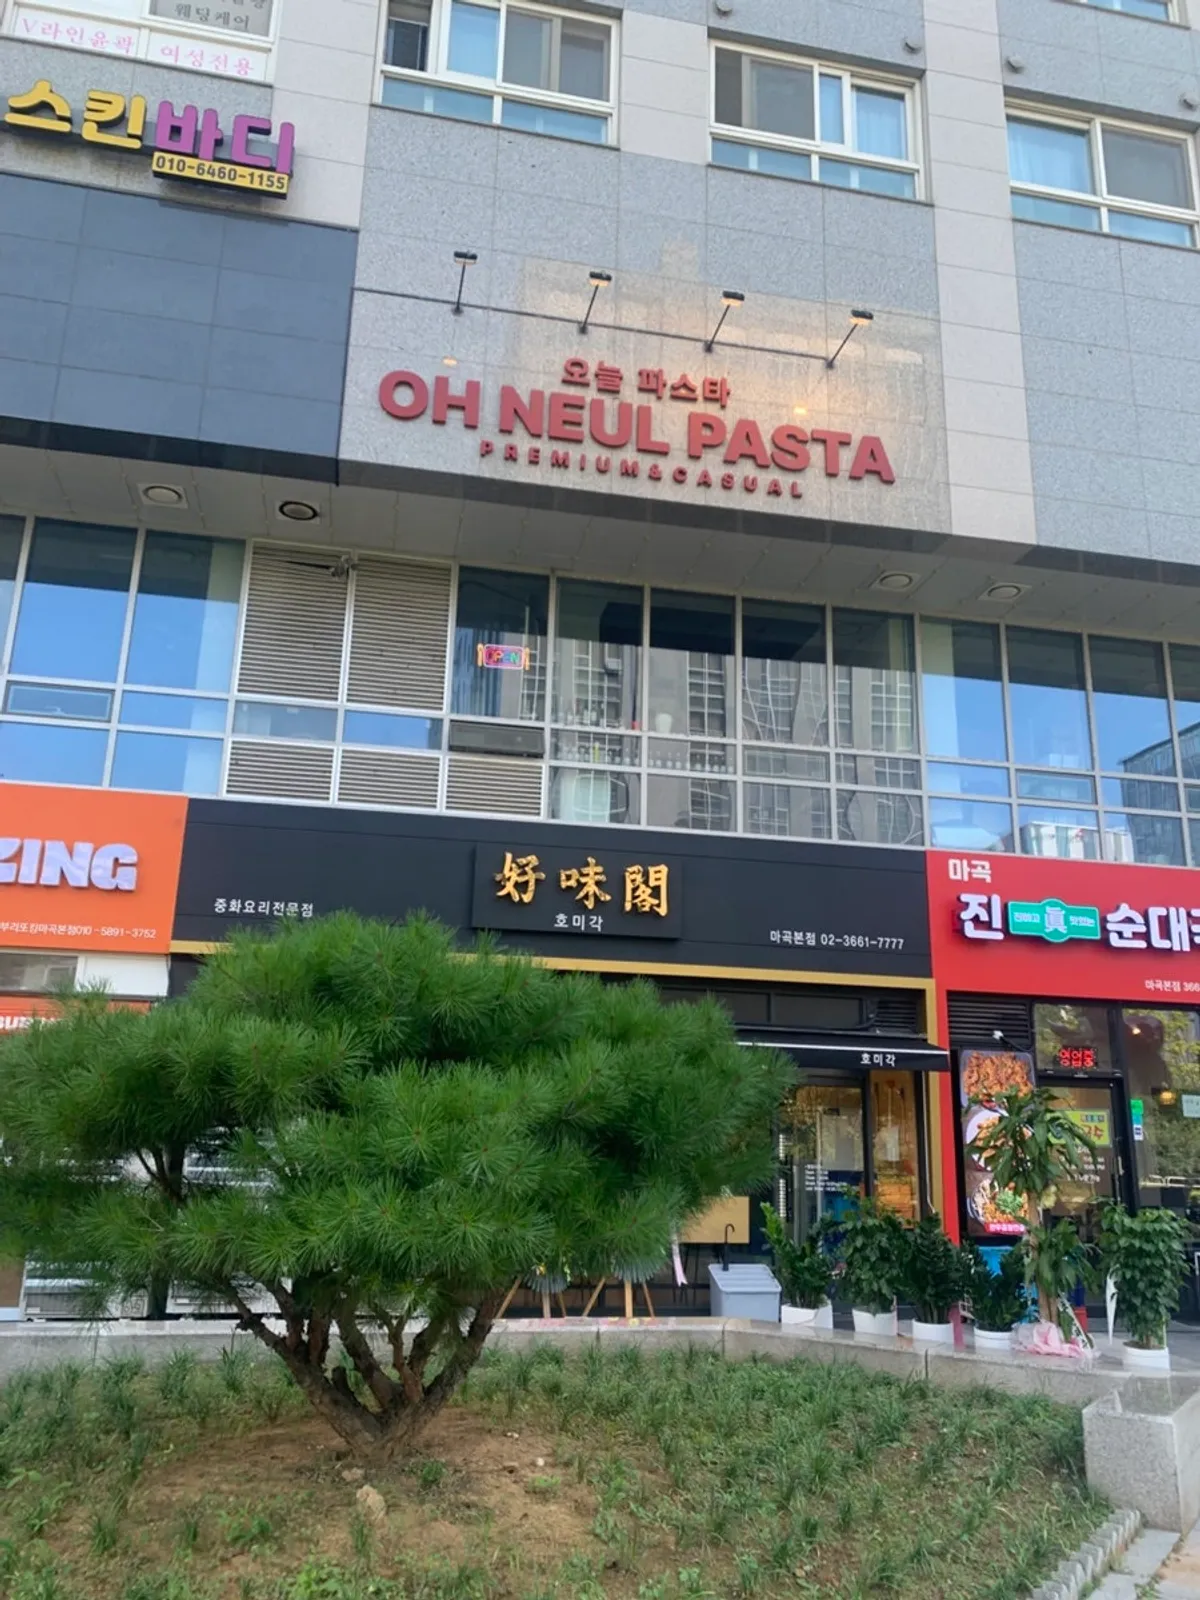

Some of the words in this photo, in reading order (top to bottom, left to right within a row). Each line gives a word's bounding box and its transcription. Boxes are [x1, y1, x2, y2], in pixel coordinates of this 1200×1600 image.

[160, 45, 254, 76] 여성전용
[154, 154, 286, 191] 010-6460-1155
[561, 357, 623, 395] 오늘
[637, 367, 731, 410] 파스타
[378, 369, 481, 430] OH
[499, 384, 670, 456] NEUL
[687, 410, 896, 484] PASTA
[494, 851, 669, 918] 好味閣
[948, 859, 992, 883] 마곡
[214, 897, 314, 918] 중화요리전문점
[554, 912, 603, 932] 호미각
[959, 893, 1005, 941] 진
[1105, 902, 1200, 952] 순대
[770, 929, 816, 947] 마곡본점
[820, 932, 904, 950] 02-3661-7777
[860, 1052, 897, 1067] 호미각
